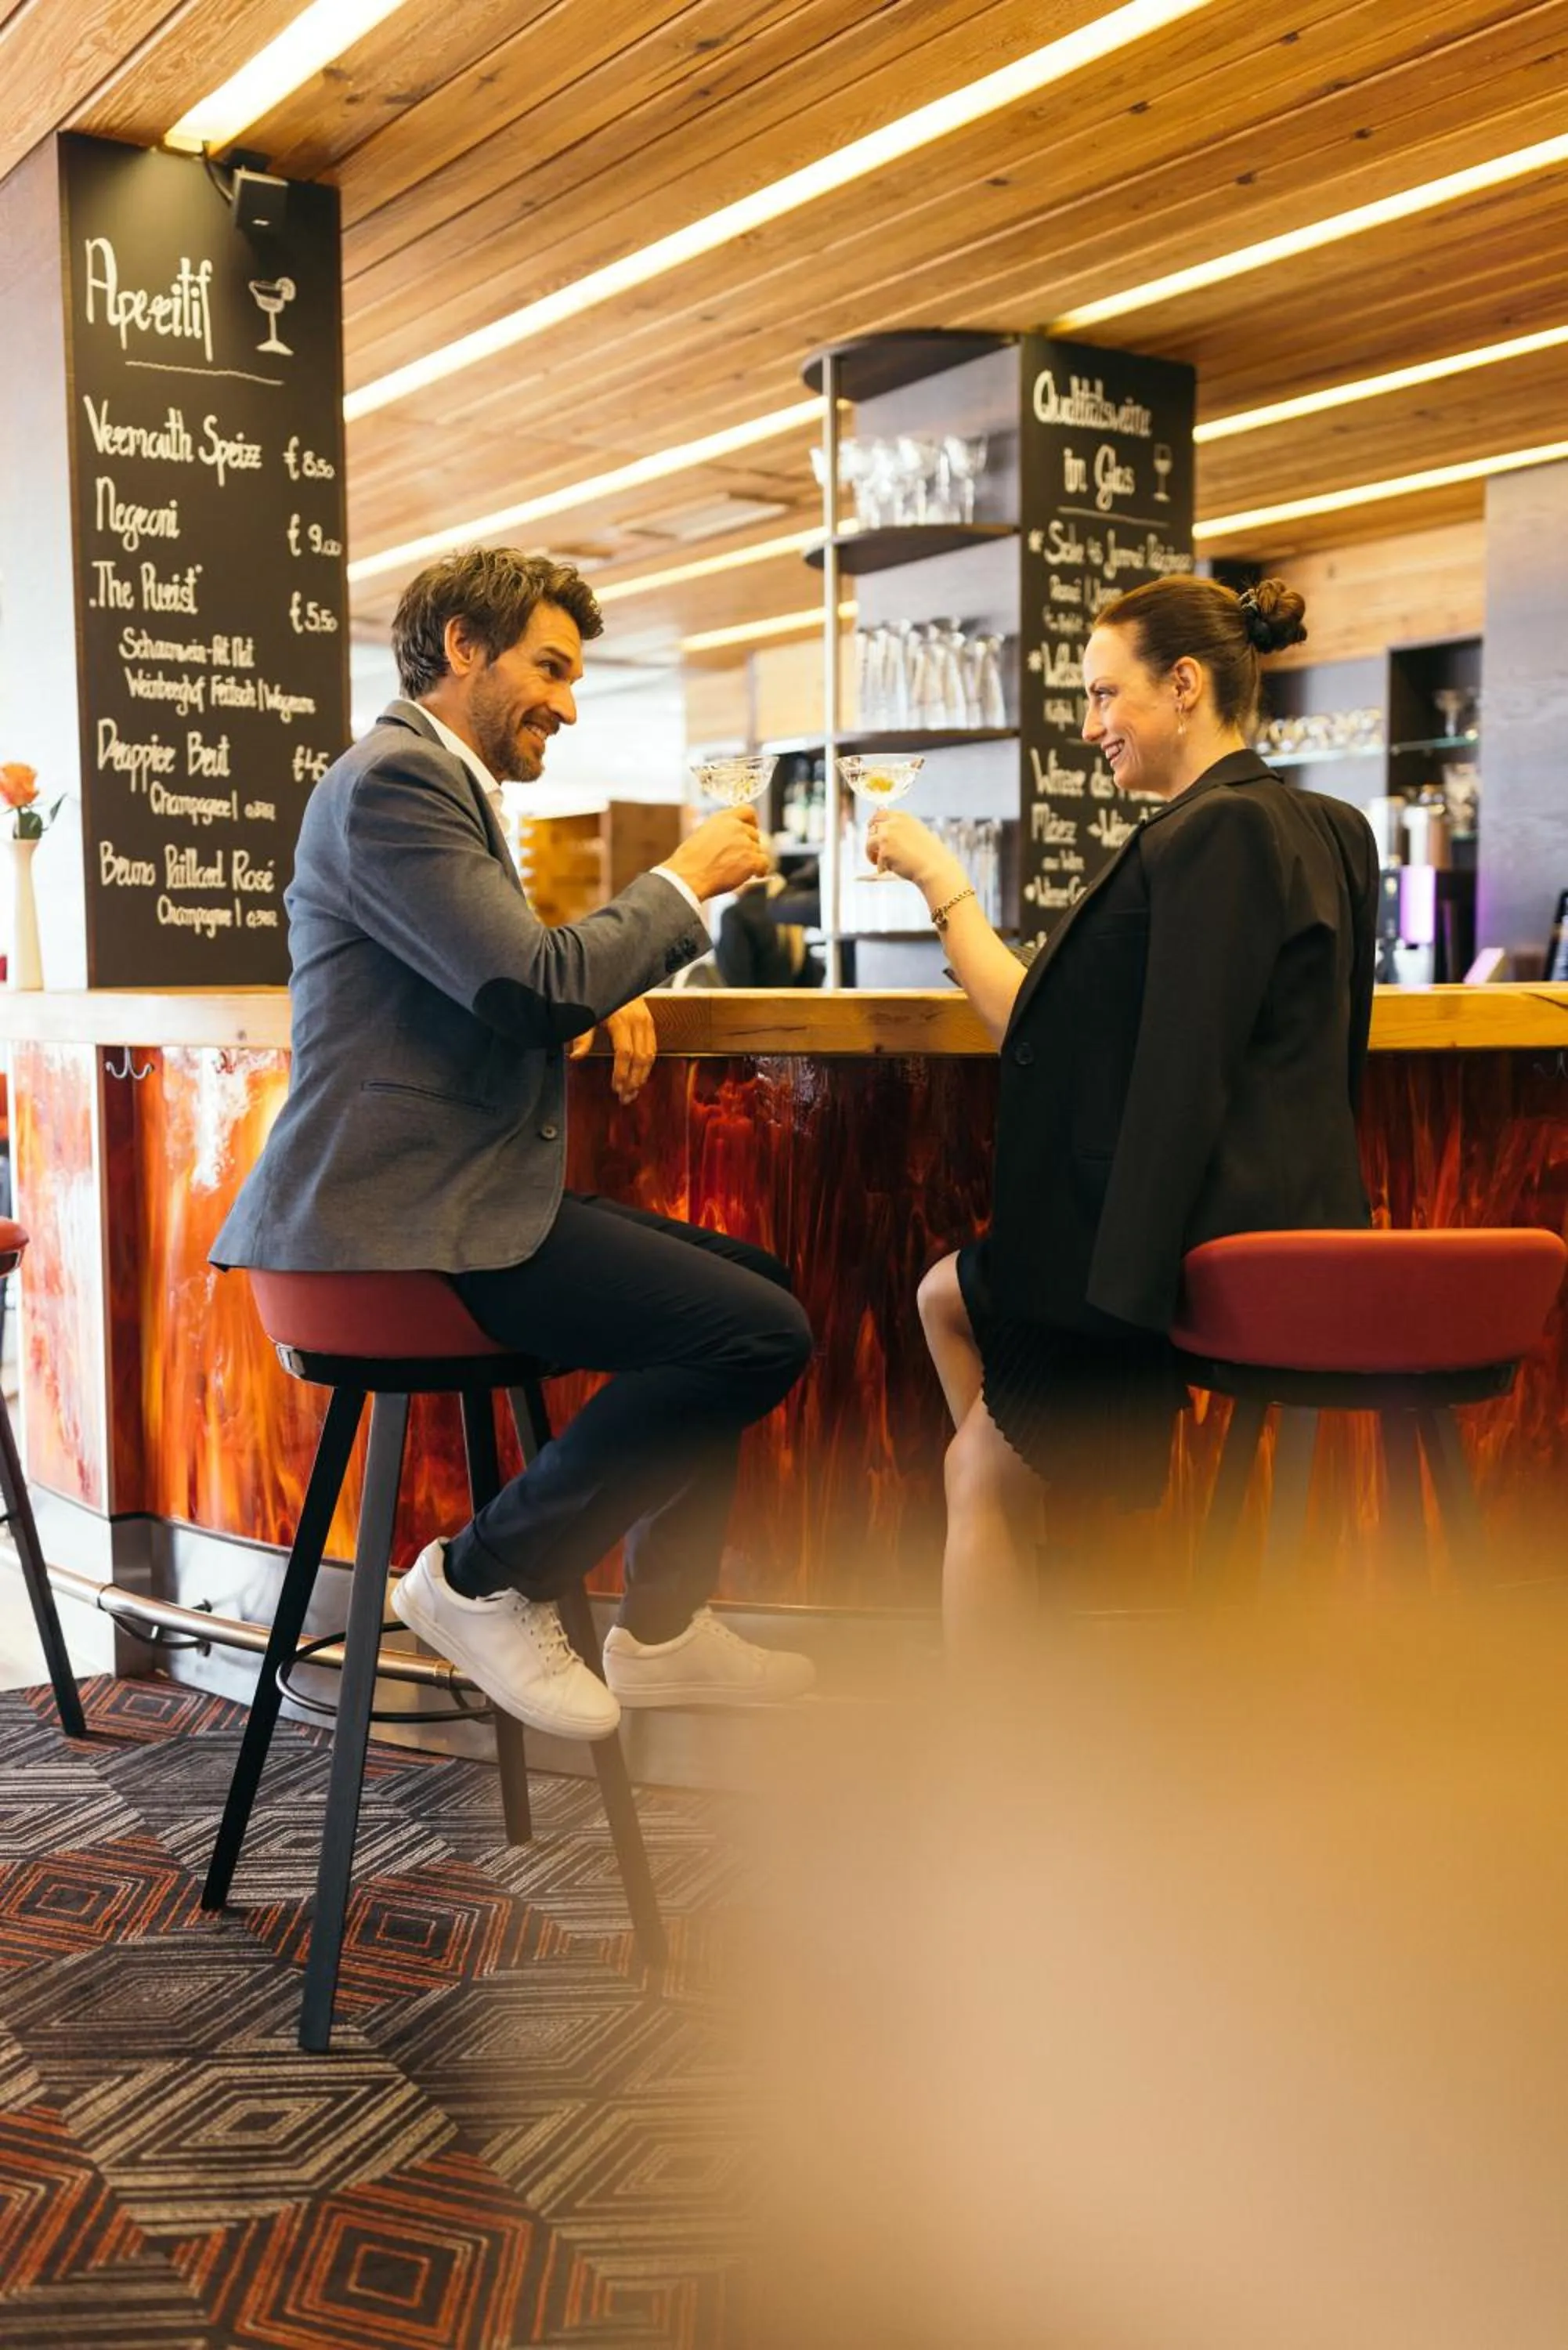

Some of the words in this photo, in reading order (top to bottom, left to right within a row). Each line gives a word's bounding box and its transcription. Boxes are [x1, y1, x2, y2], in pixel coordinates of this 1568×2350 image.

[86, 238, 212, 361] Aperitif
[96, 476, 179, 551] Negroni
[98, 718, 175, 794] Drappier
[188, 732, 229, 776] Brut
[100, 841, 155, 886] Bruno
[233, 850, 274, 892] Rosé
